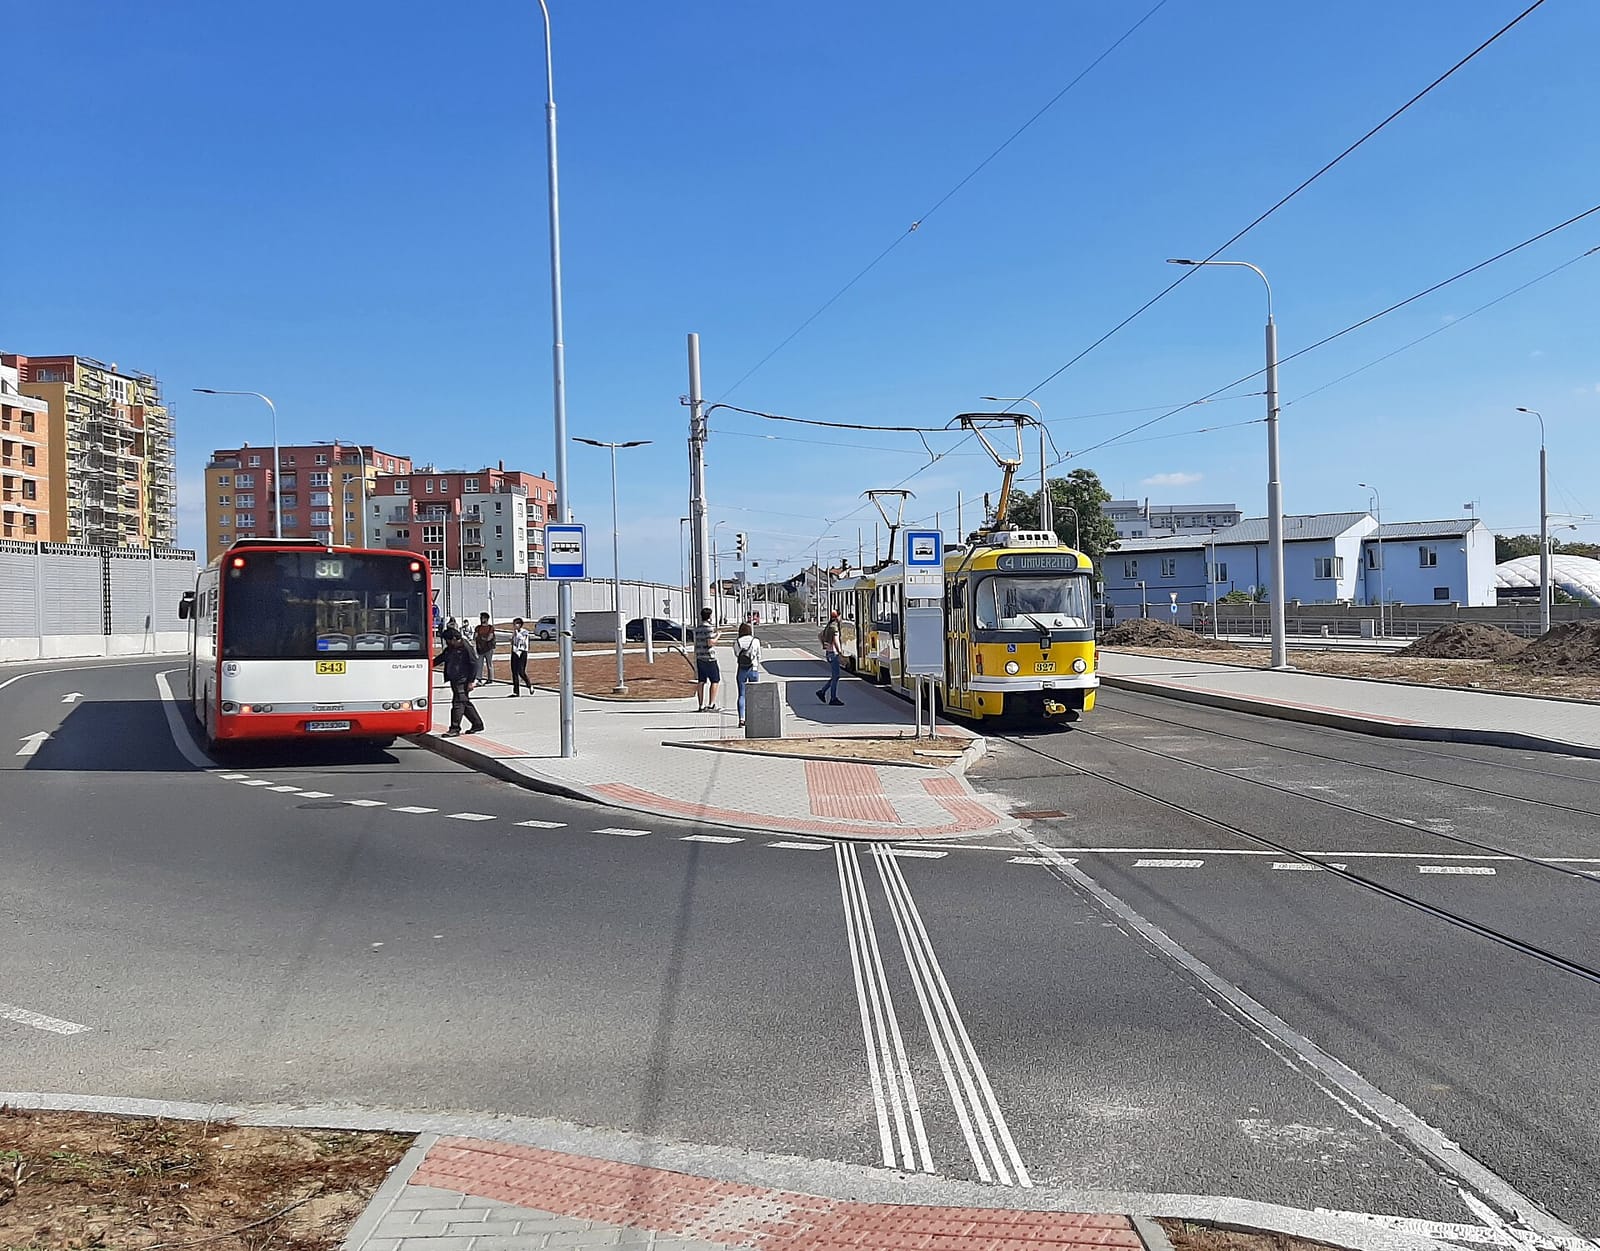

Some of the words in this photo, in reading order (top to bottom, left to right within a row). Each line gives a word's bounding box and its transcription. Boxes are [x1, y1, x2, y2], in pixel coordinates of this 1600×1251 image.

[316, 560, 342, 577] 30
[1005, 557, 1014, 569] 4
[1021, 557, 1071, 569] UNIVERZITA
[319, 662, 343, 673] 543
[1036, 663, 1054, 672] 327
